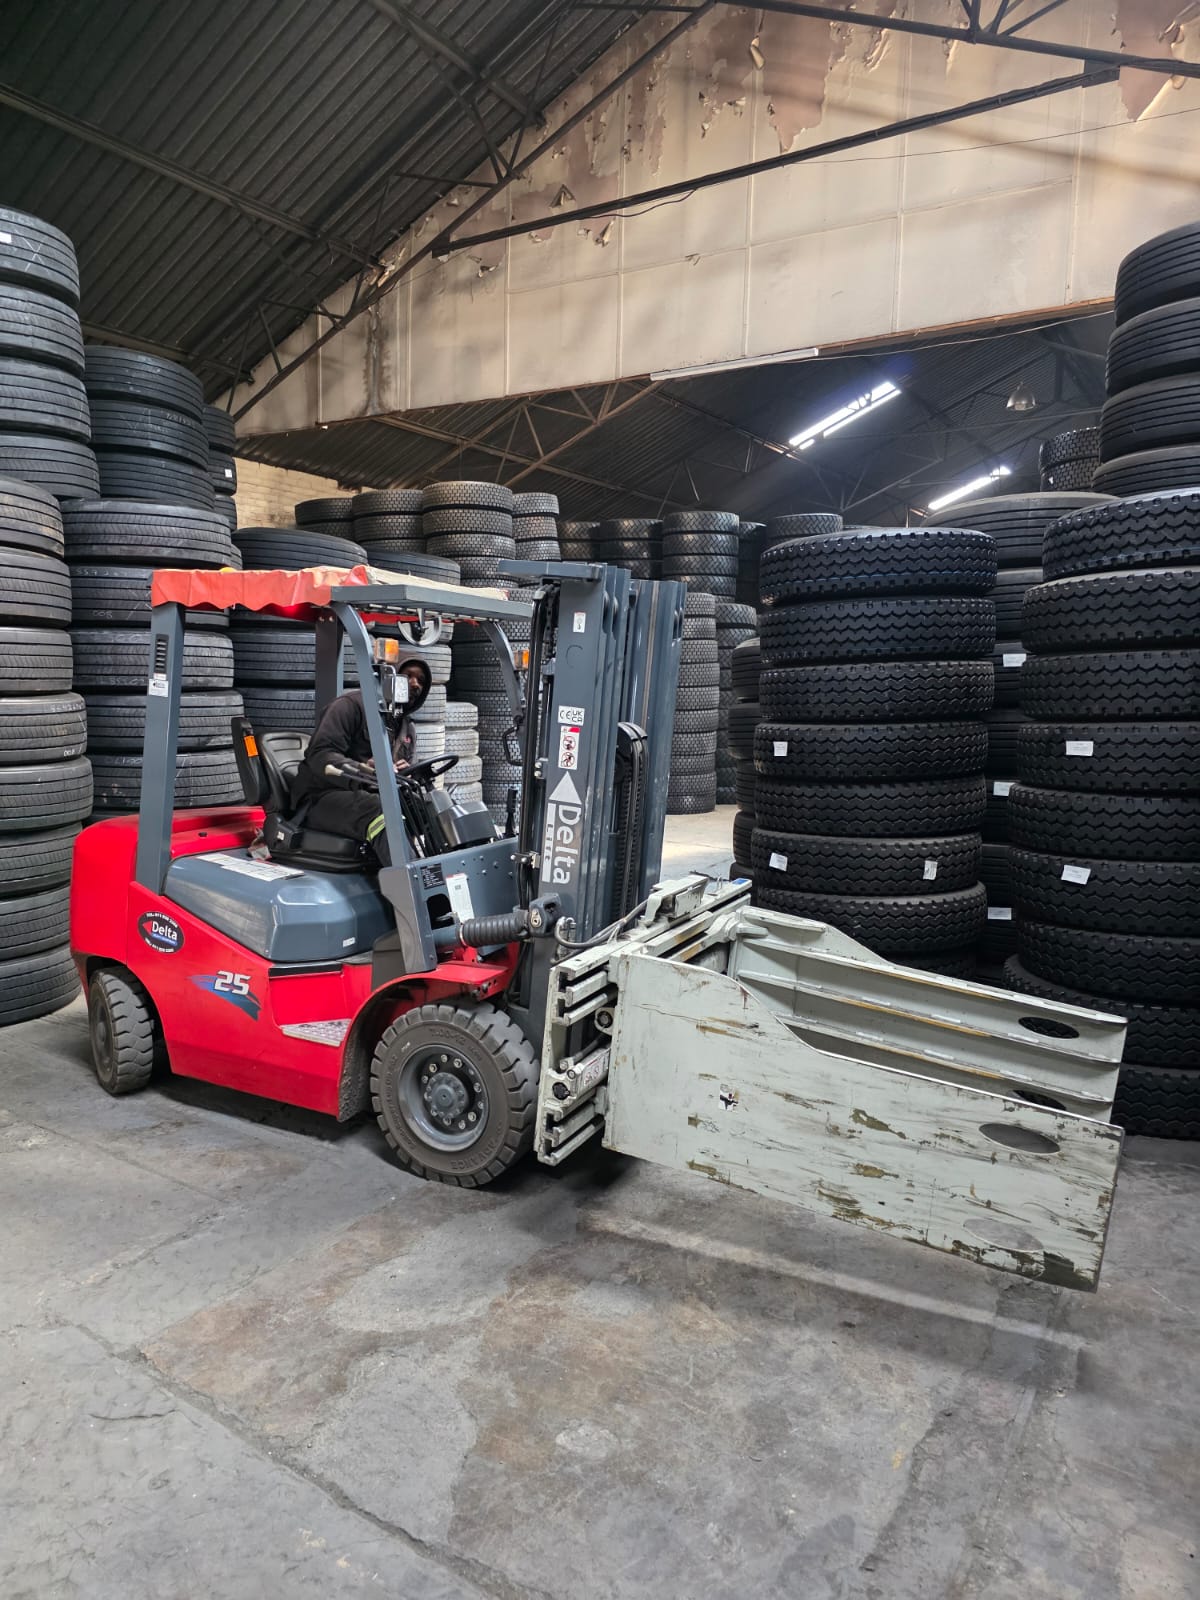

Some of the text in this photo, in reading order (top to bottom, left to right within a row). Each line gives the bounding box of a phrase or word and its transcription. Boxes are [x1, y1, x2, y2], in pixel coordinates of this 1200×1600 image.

[552, 804, 582, 884] Delta
[152, 921, 178, 941] Delta
[214, 970, 251, 995] 25
